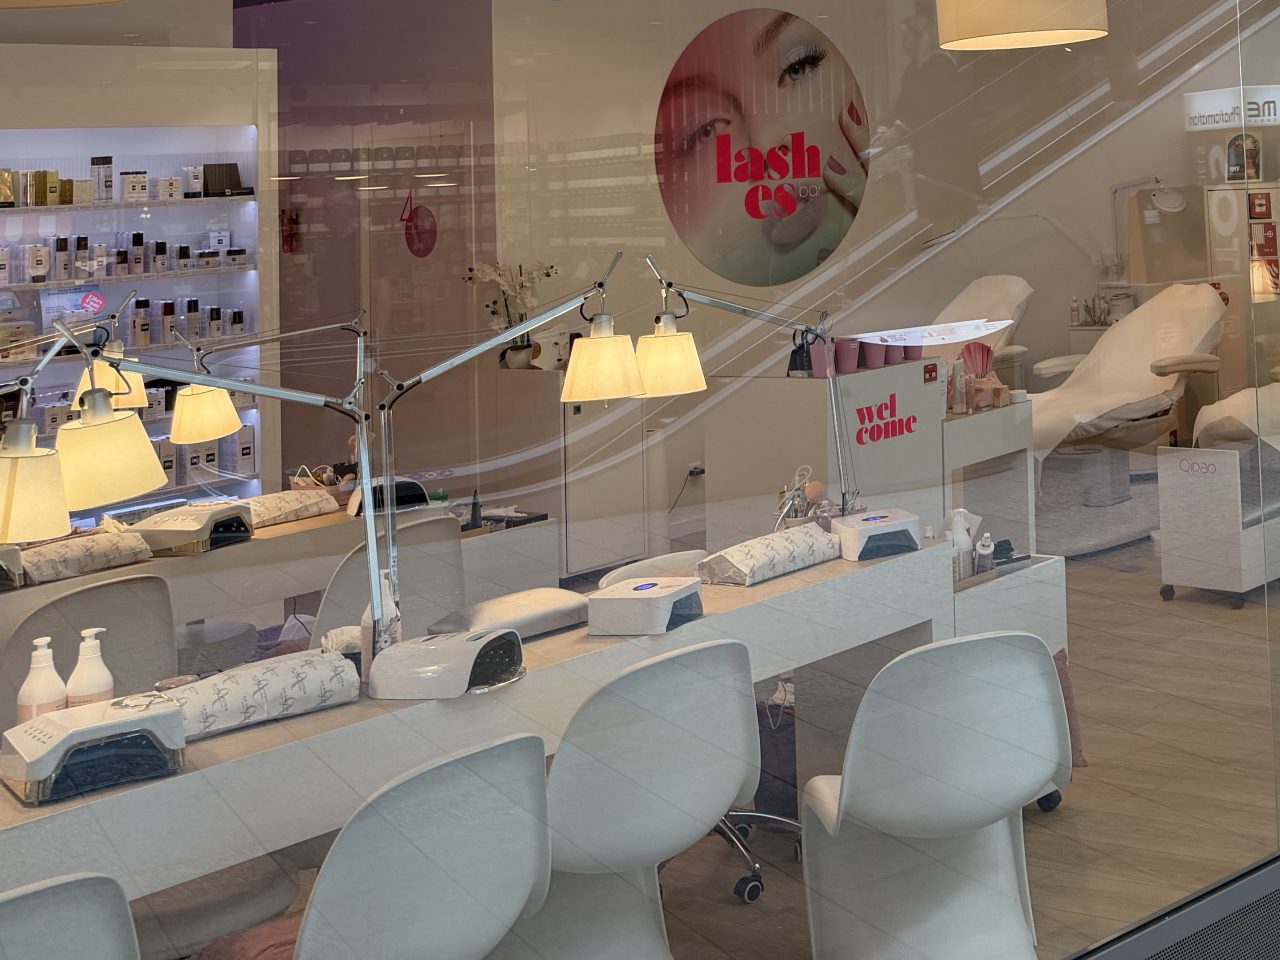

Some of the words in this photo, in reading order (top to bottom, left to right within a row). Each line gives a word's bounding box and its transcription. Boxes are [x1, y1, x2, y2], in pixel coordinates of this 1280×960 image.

[714, 131, 821, 183] lash
[744, 182, 798, 220] es
[856, 392, 896, 425] wel
[856, 416, 918, 445] come
[1180, 458, 1217, 477] Qipao
